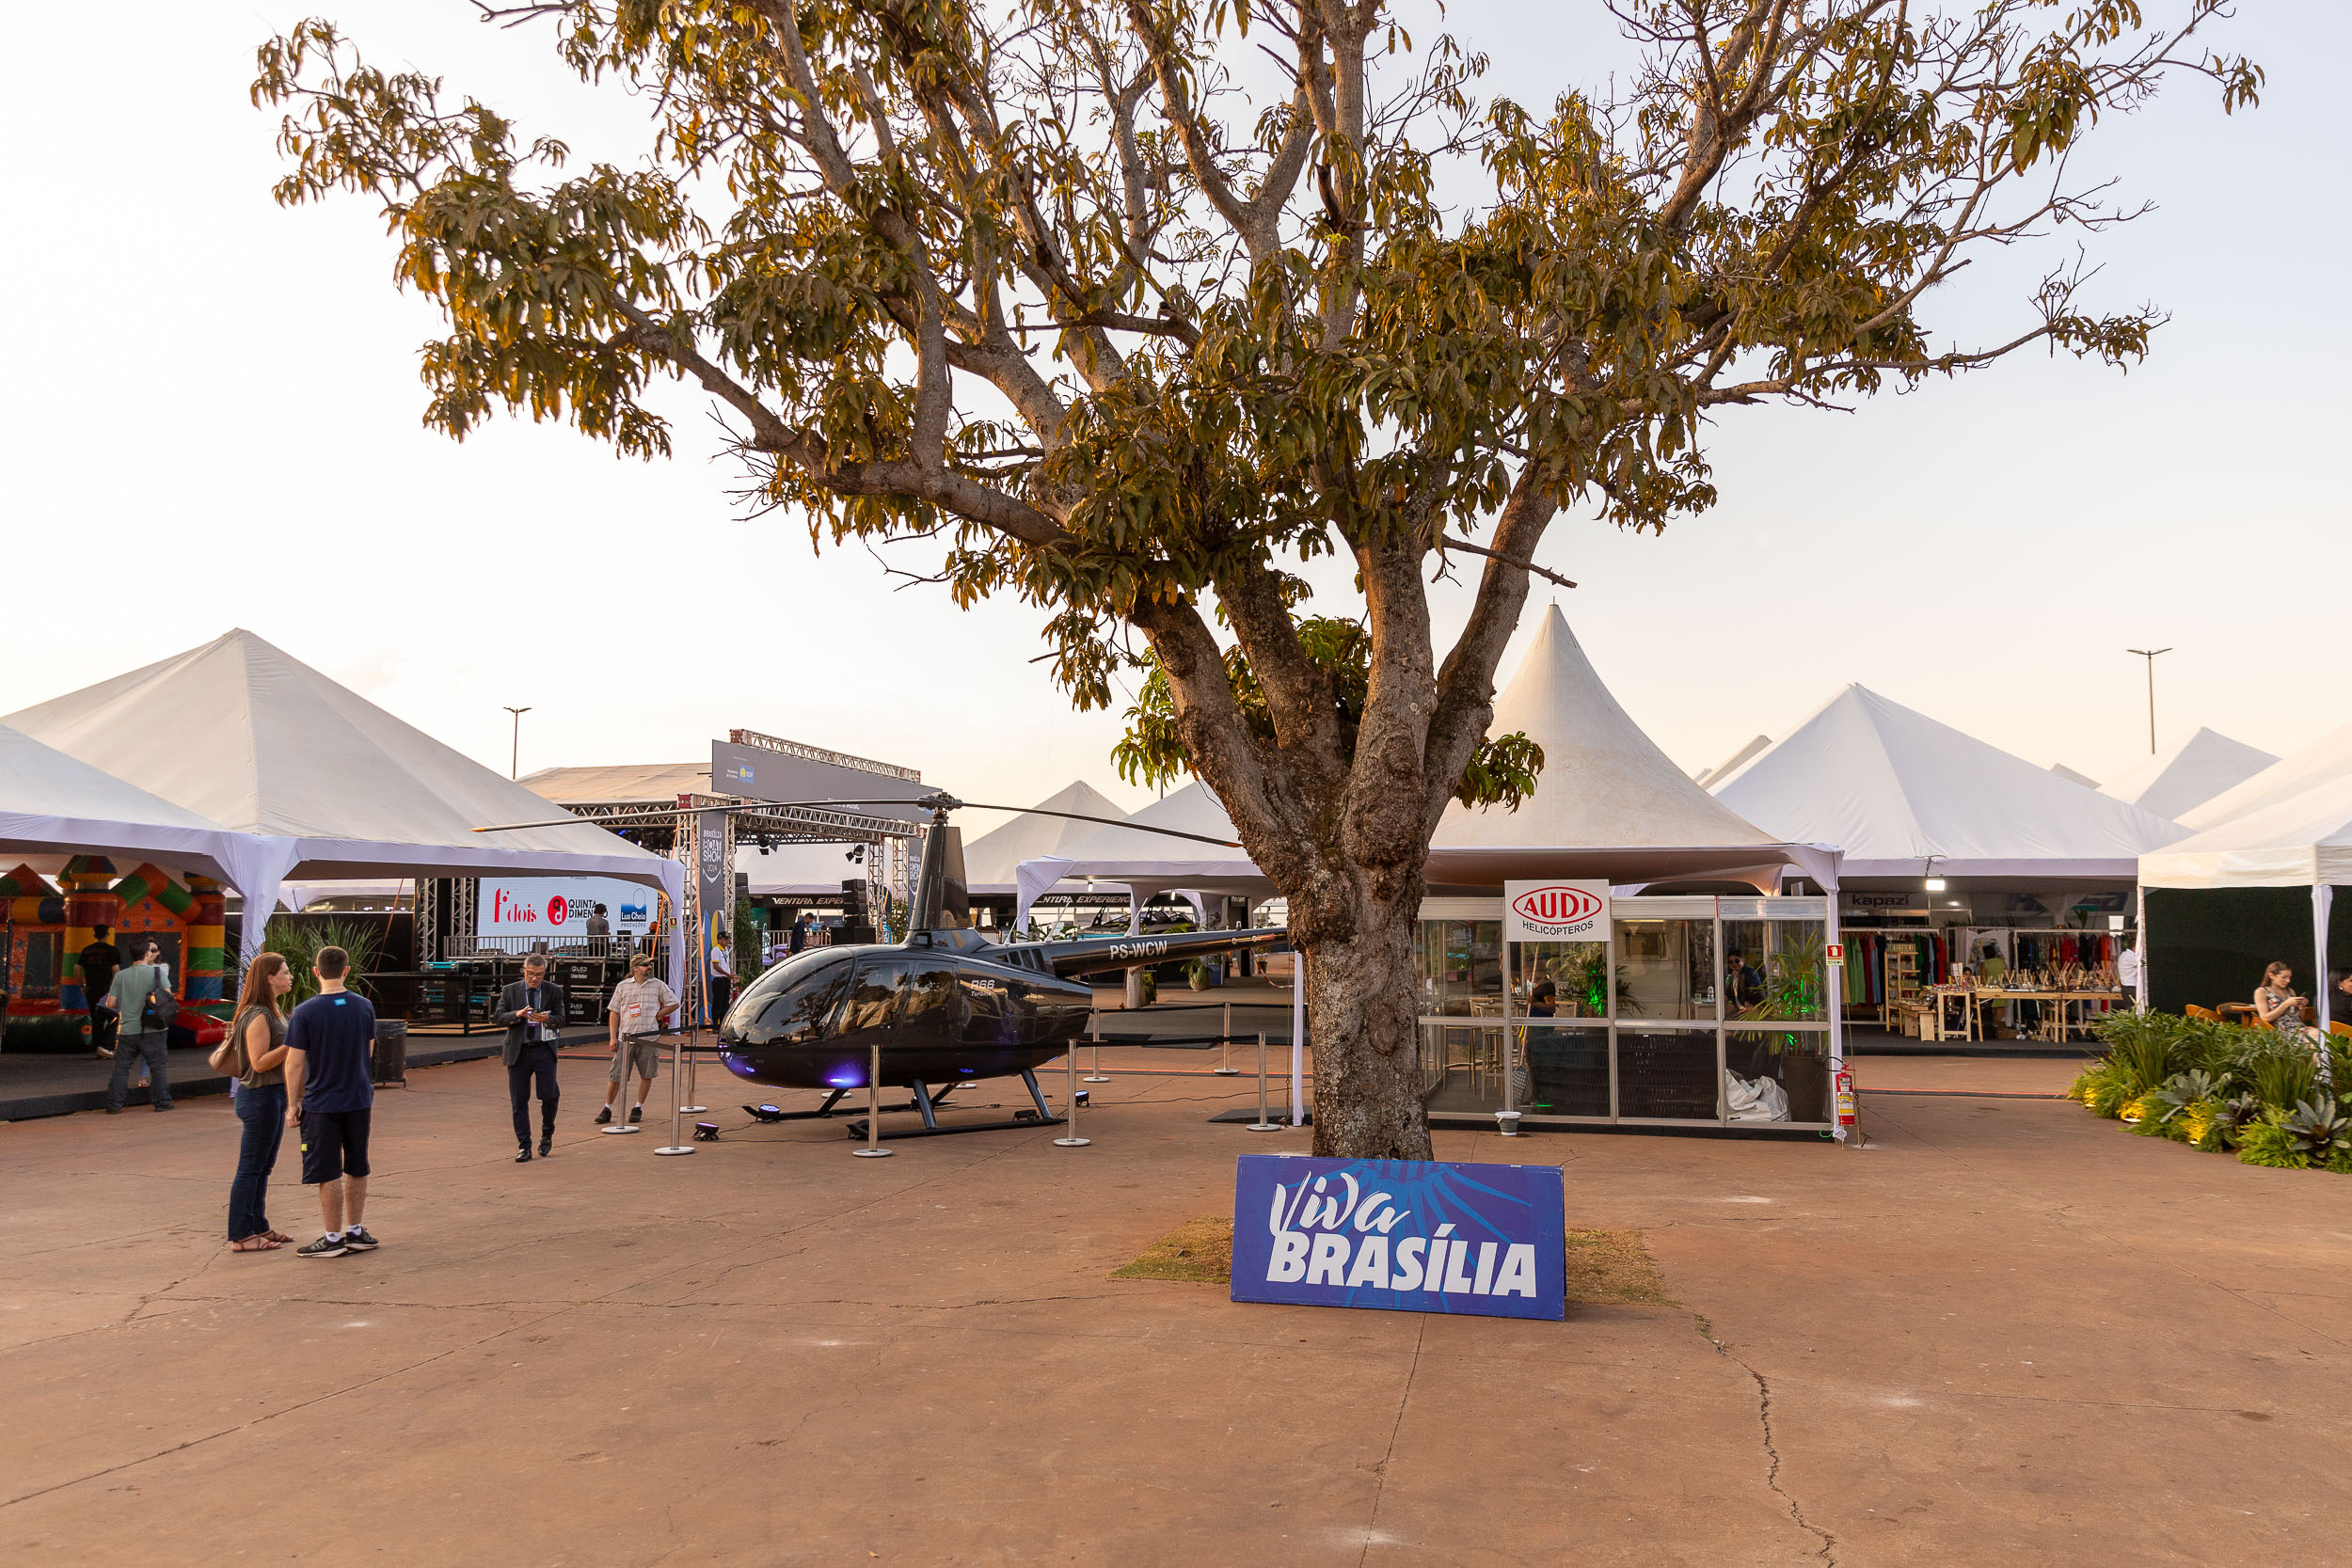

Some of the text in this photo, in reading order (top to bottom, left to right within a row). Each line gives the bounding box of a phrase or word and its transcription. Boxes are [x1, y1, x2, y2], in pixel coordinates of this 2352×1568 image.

[703, 850, 722, 863] SHOW
[1523, 893, 1590, 918] AUDI
[1851, 895, 1909, 908] kapazi
[1522, 920, 1594, 935] HELICÓPTEROS
[1109, 941, 1168, 959] PS-WCW
[971, 979, 995, 989] R66
[1269, 1170, 1411, 1237] Viva
[1265, 1223, 1537, 1298] BRASÍLIA
